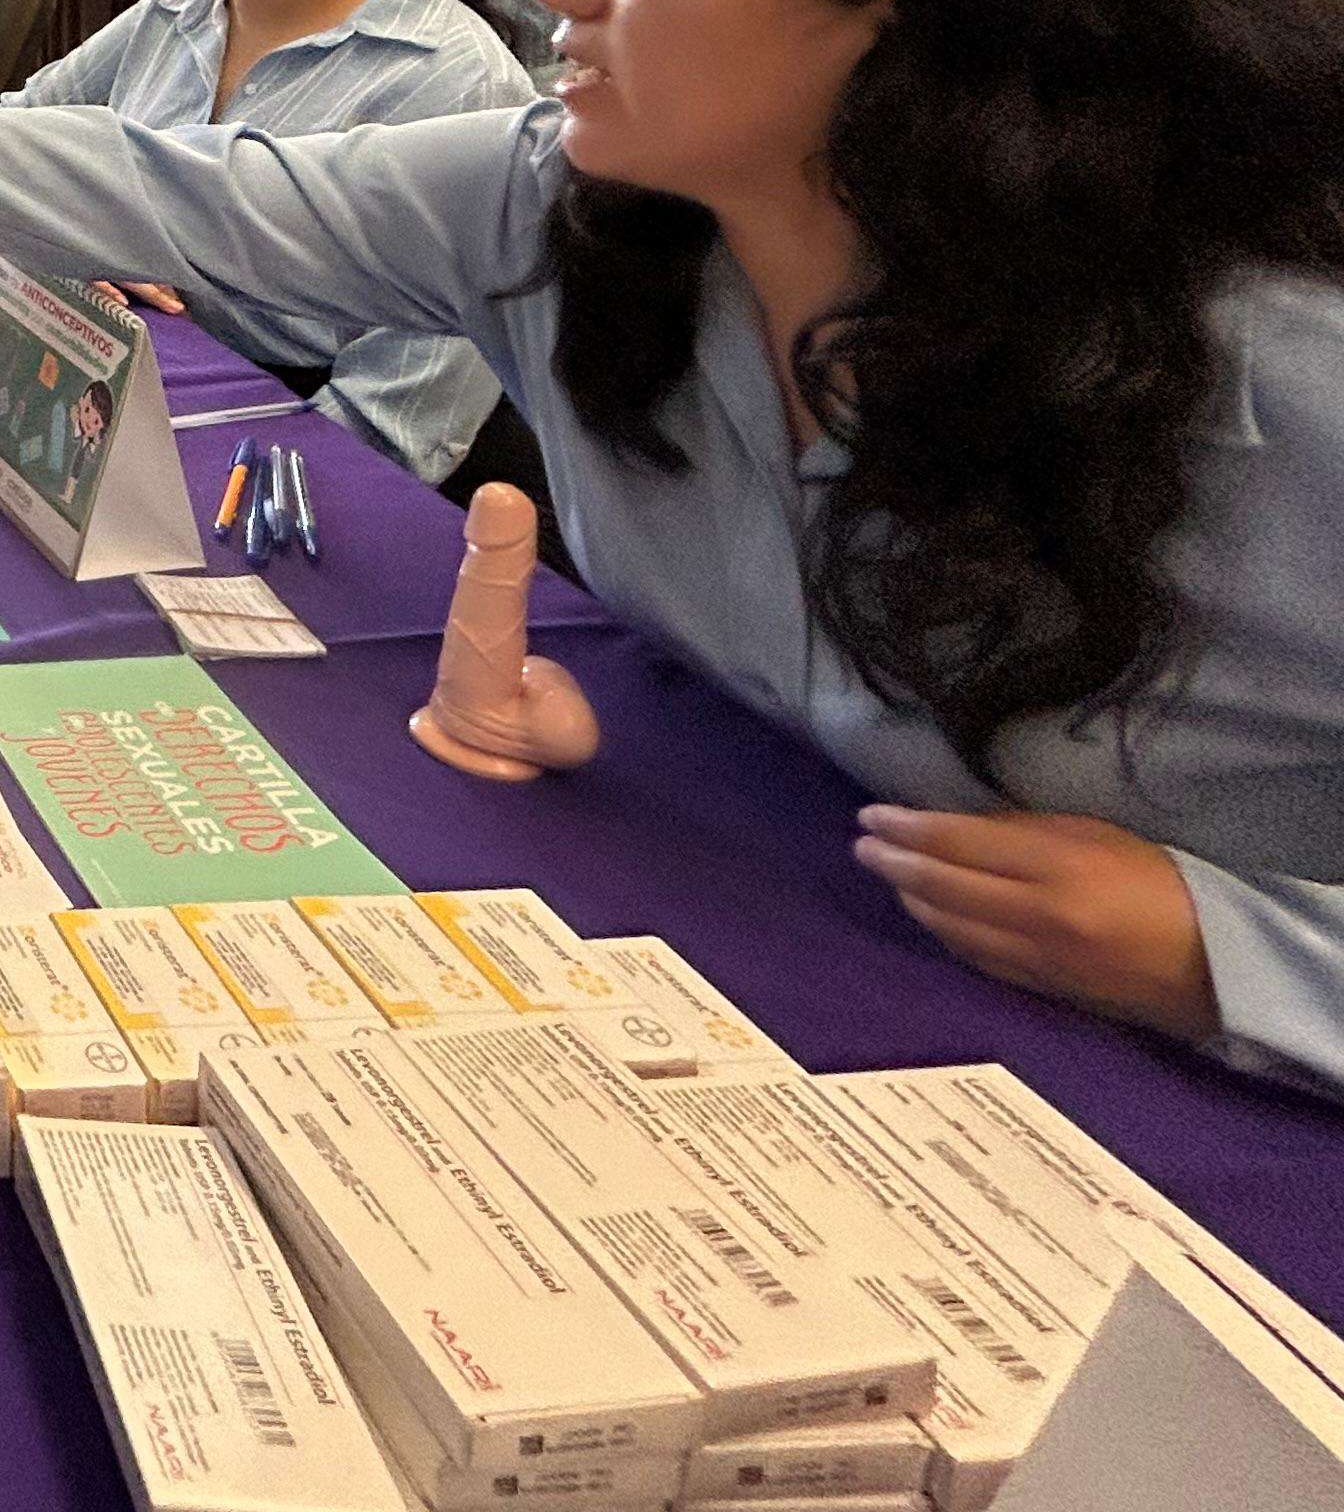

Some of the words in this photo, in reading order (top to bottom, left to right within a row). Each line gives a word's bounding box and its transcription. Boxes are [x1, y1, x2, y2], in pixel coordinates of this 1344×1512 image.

[22, 284, 114, 358] ANTICONCEPTIVOS
[100, 709, 234, 855] SEXUALES
[140, 708, 305, 853] DERECHOS
[197, 705, 339, 849] CARTILLA
[345, 1048, 441, 1146] Levonorgestrel
[445, 1167, 503, 1221] Ethinyl
[494, 1221, 566, 1296] Estradiol
[549, 1022, 659, 1116] Levonorgestrel
[669, 1136, 735, 1188] Ethinyl
[726, 1187, 809, 1259] Estradiol
[194, 1138, 258, 1245] Levonorgestrel
[251, 1267, 297, 1328] Ethinyl
[281, 1324, 337, 1409] Estradiol
[899, 1203, 974, 1256] Ethinyl
[963, 1259, 1058, 1333] Estradiol
